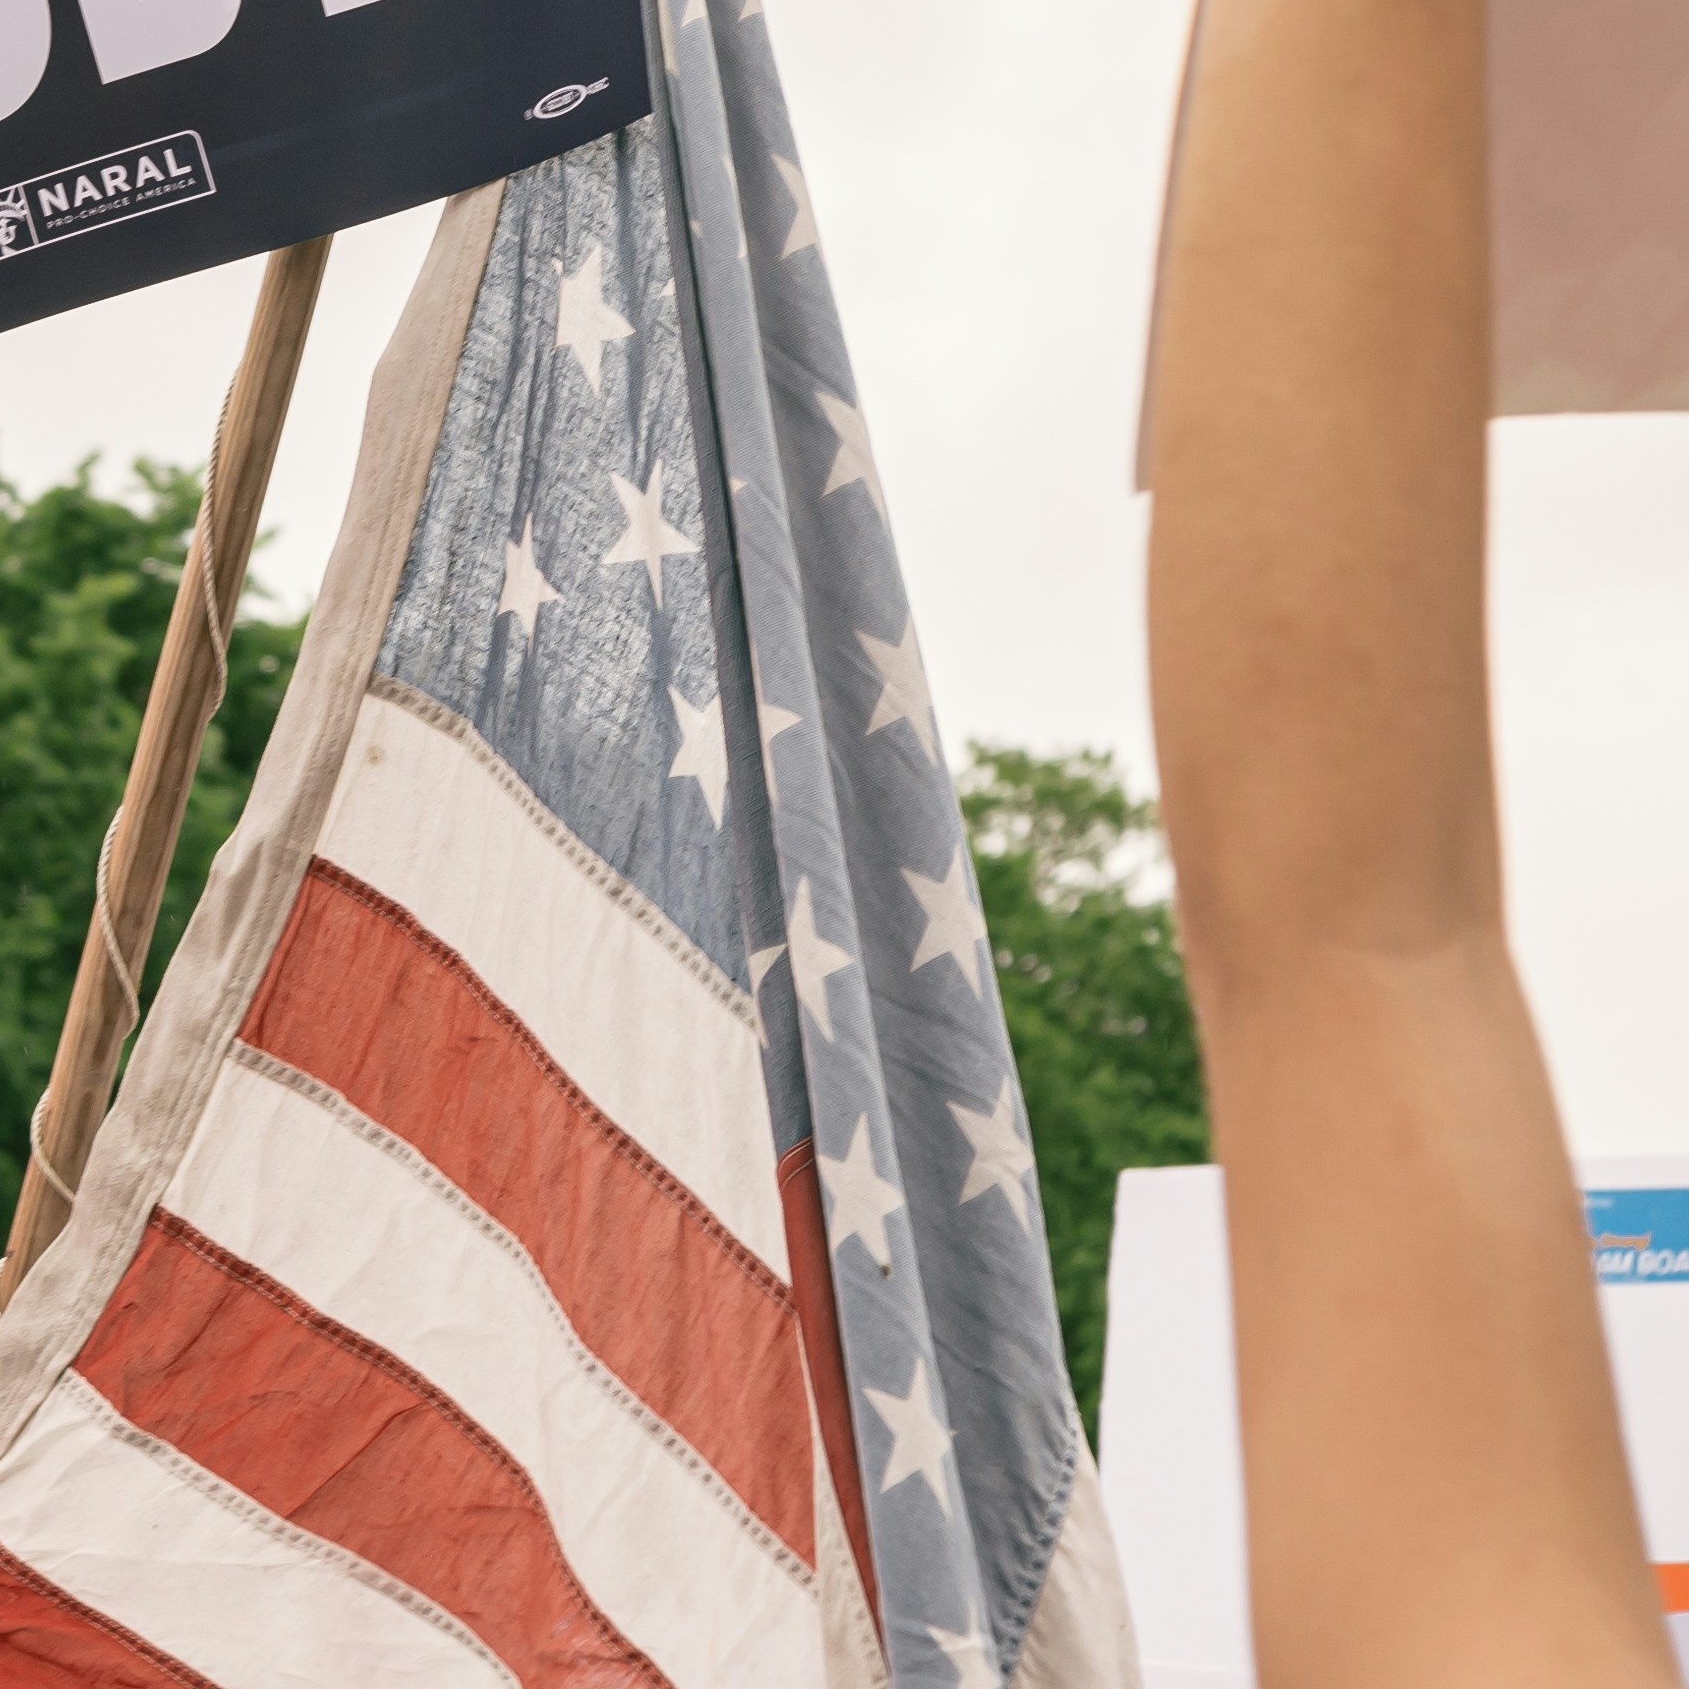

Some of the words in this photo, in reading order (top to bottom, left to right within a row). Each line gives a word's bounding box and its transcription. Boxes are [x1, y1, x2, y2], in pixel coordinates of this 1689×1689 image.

[37, 148, 193, 217] NARAL
[46, 196, 131, 230] PRO-CHOICE
[135, 177, 198, 203] AMERICA
